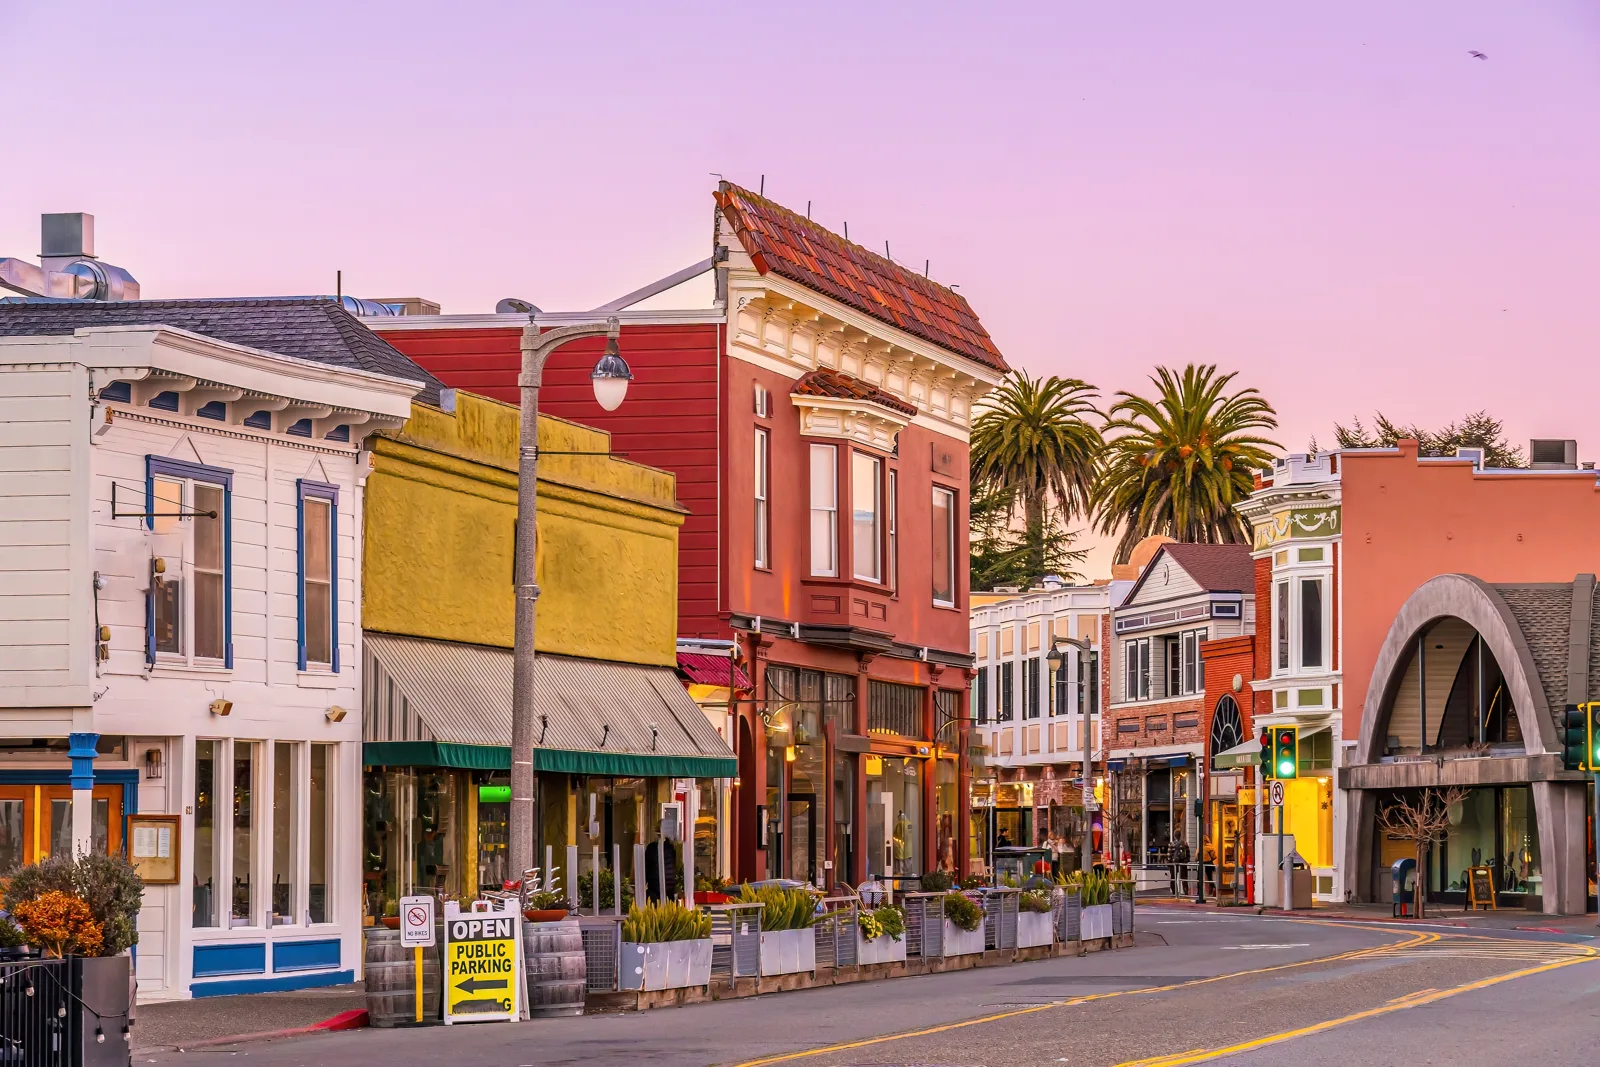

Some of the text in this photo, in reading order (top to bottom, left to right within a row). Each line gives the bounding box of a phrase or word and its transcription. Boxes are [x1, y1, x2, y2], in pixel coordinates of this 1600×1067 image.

[453, 919, 511, 940] OPEN
[457, 943, 506, 959] PUBLIC
[452, 959, 511, 975] PARKING
